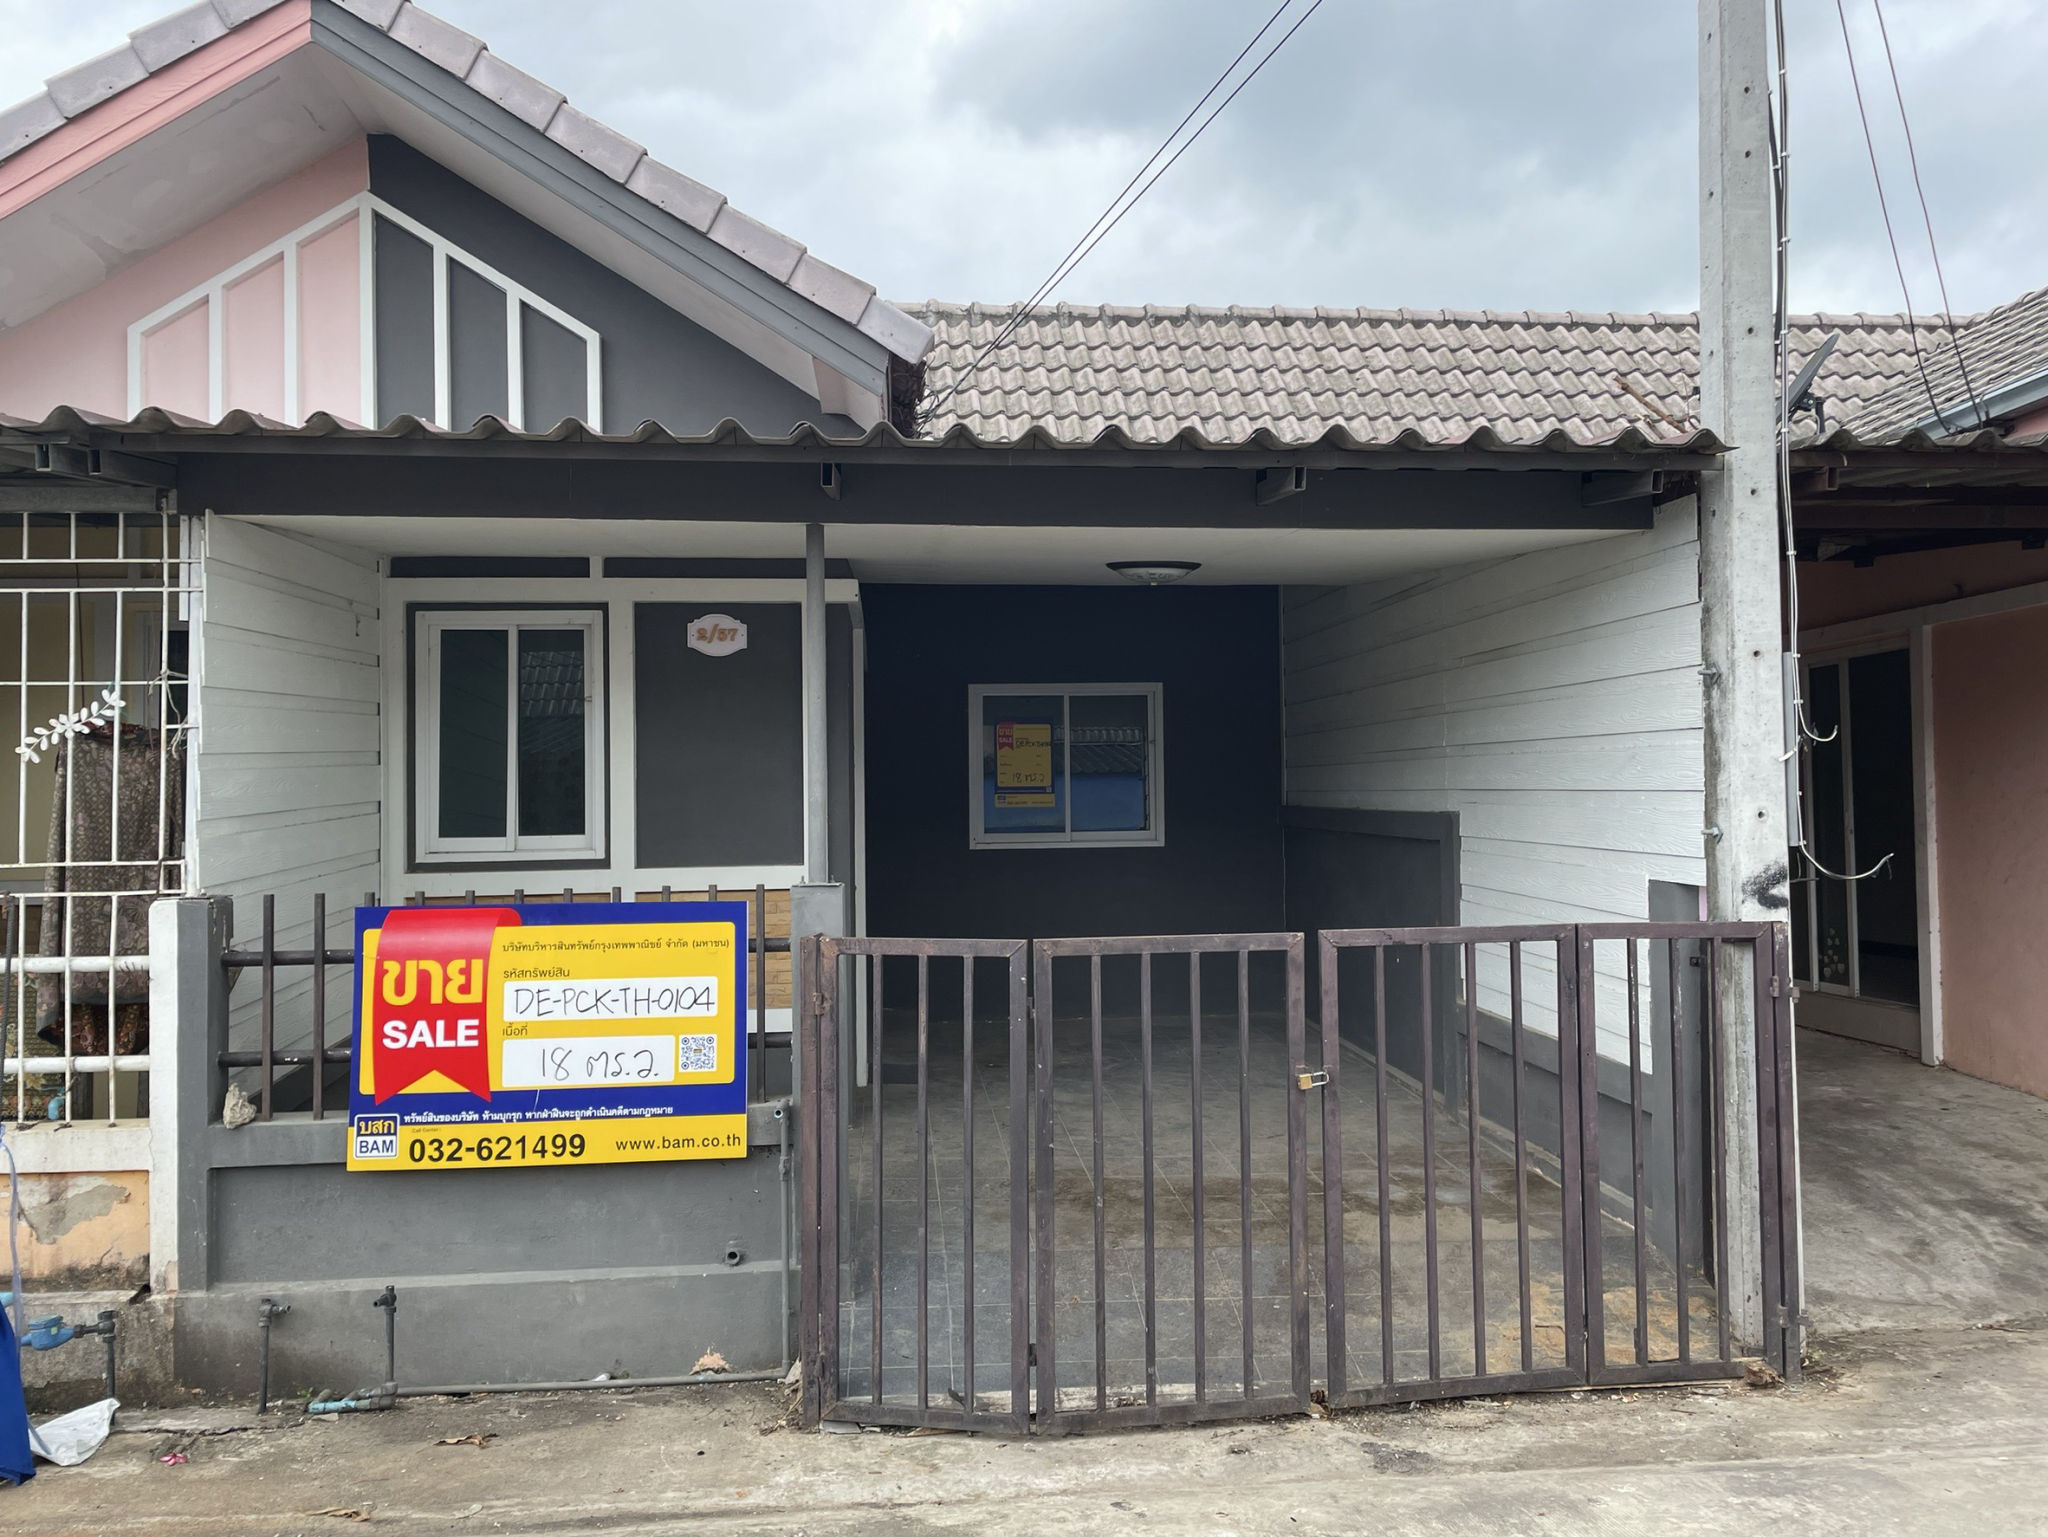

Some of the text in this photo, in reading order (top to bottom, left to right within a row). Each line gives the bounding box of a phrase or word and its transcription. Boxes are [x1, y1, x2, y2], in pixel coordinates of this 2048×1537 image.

[502, 937, 730, 953] บริษัทบริหารสินทรัพย์กรุงเทพพาณิชย์ จำกัด (มหาชน)
[503, 966, 570, 979] รหัสทรัพย์สิน
[382, 959, 484, 1006] ขาย
[514, 986, 716, 1017] DE-PCK-TH-0104
[382, 1019, 479, 1049] SALE
[502, 1022, 528, 1037] เนื้อที่
[541, 1047, 573, 1081] 18
[403, 1110, 479, 1123] ทรัพย์สินของบริษัท
[482, 1109, 522, 1123] ห้ามบุกรุก
[359, 1119, 395, 1135] บสก
[359, 1139, 394, 1154] BAM
[408, 1133, 586, 1163] 032-621499
[615, 1133, 741, 1151] www.bam.co.th
